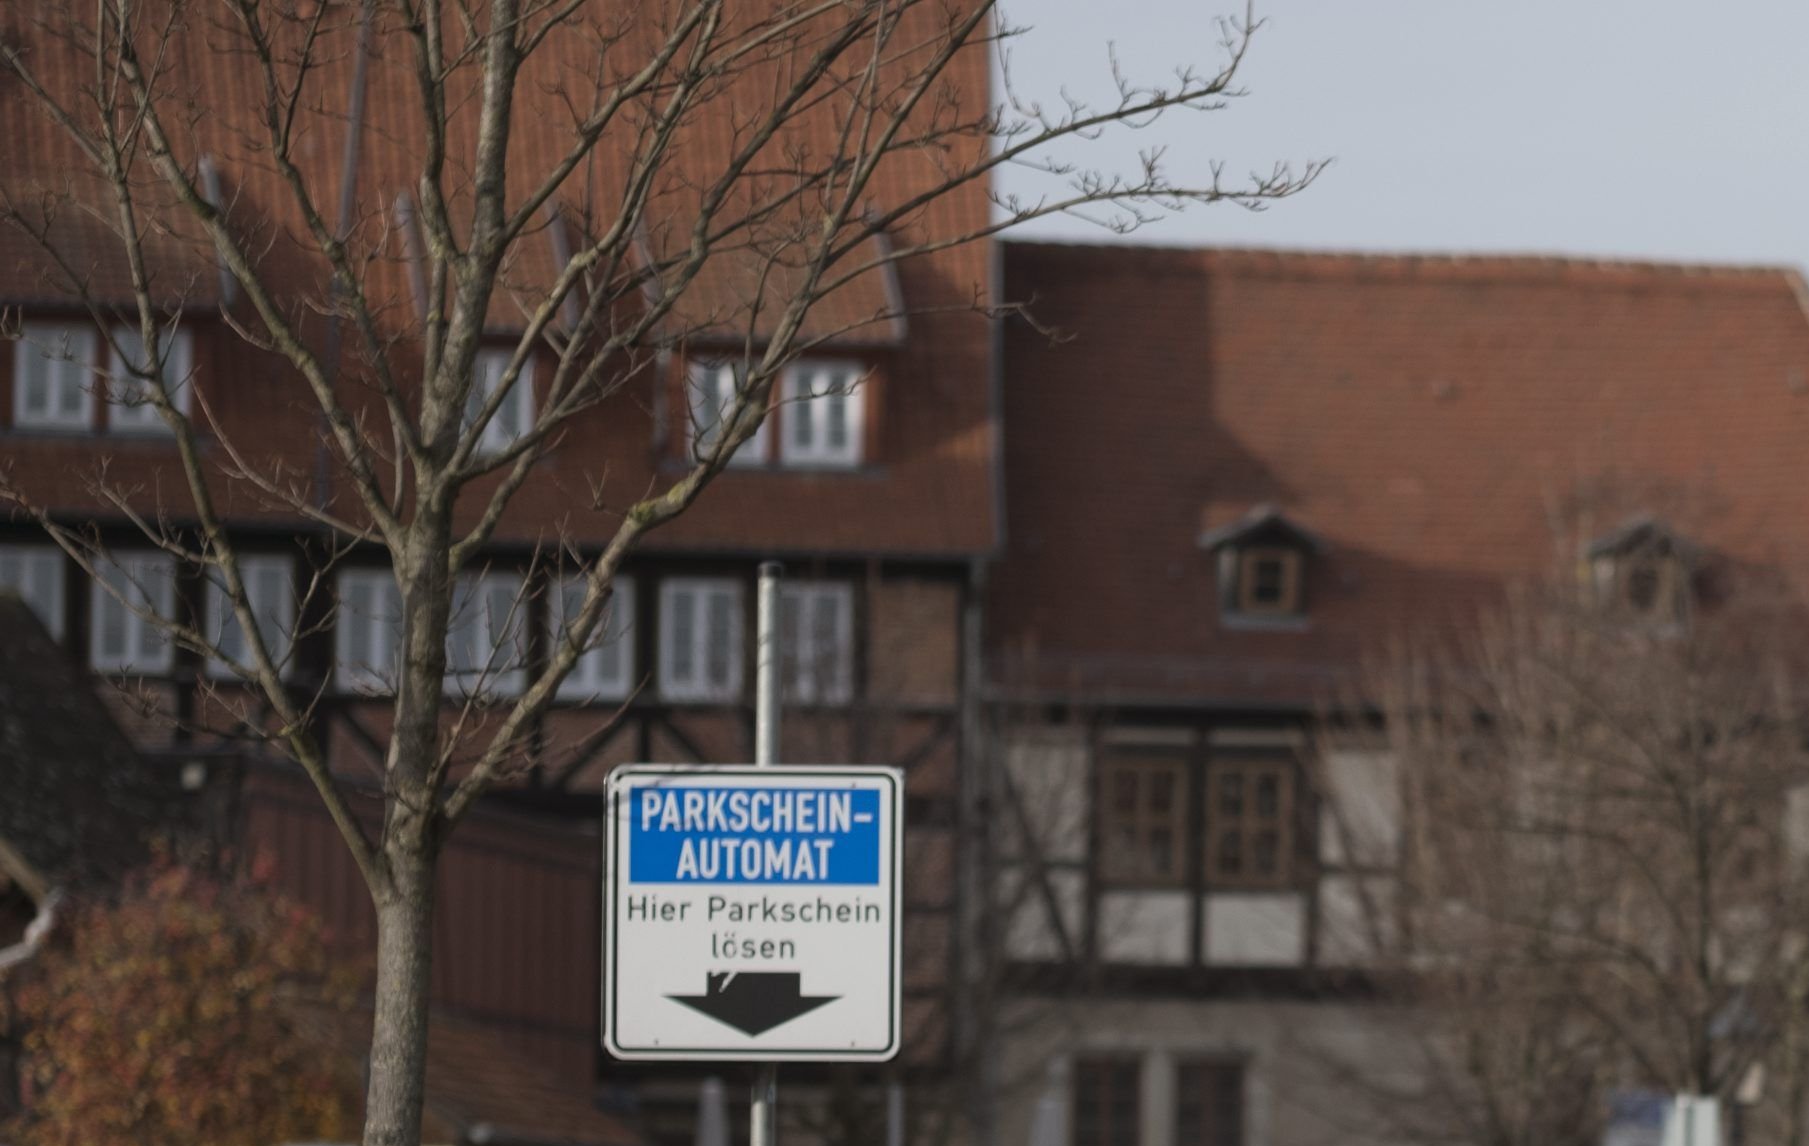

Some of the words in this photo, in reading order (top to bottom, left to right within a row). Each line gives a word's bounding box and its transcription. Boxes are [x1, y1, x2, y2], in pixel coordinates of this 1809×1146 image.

[641, 790, 873, 833] PARKSCHEIN-
[676, 838, 835, 880] AUTOMAT
[627, 895, 692, 922] Hier
[708, 895, 881, 923] Parkschein
[712, 931, 796, 959] lösen
